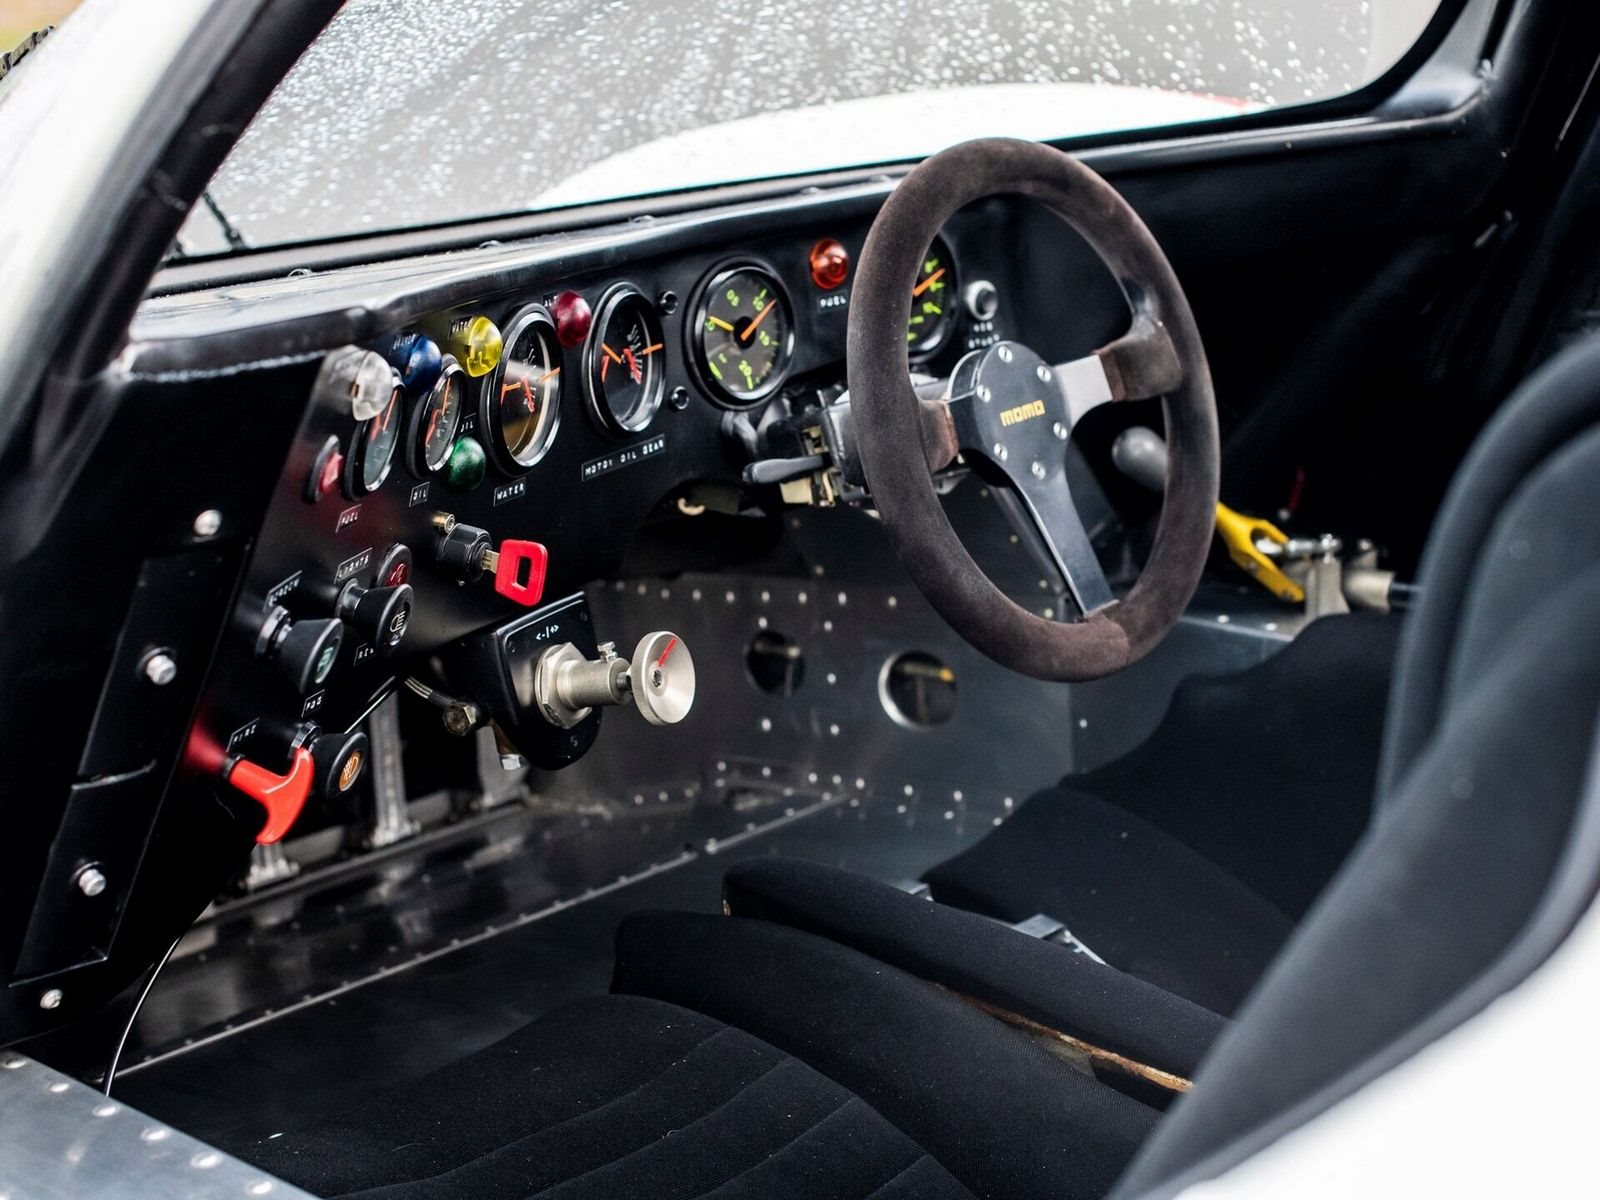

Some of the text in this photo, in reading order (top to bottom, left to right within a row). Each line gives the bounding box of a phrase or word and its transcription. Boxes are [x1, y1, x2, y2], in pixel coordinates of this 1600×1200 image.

[621, 451, 637, 463] OIL
[413, 489, 427, 501] OIL
[497, 483, 525, 500] WATER
